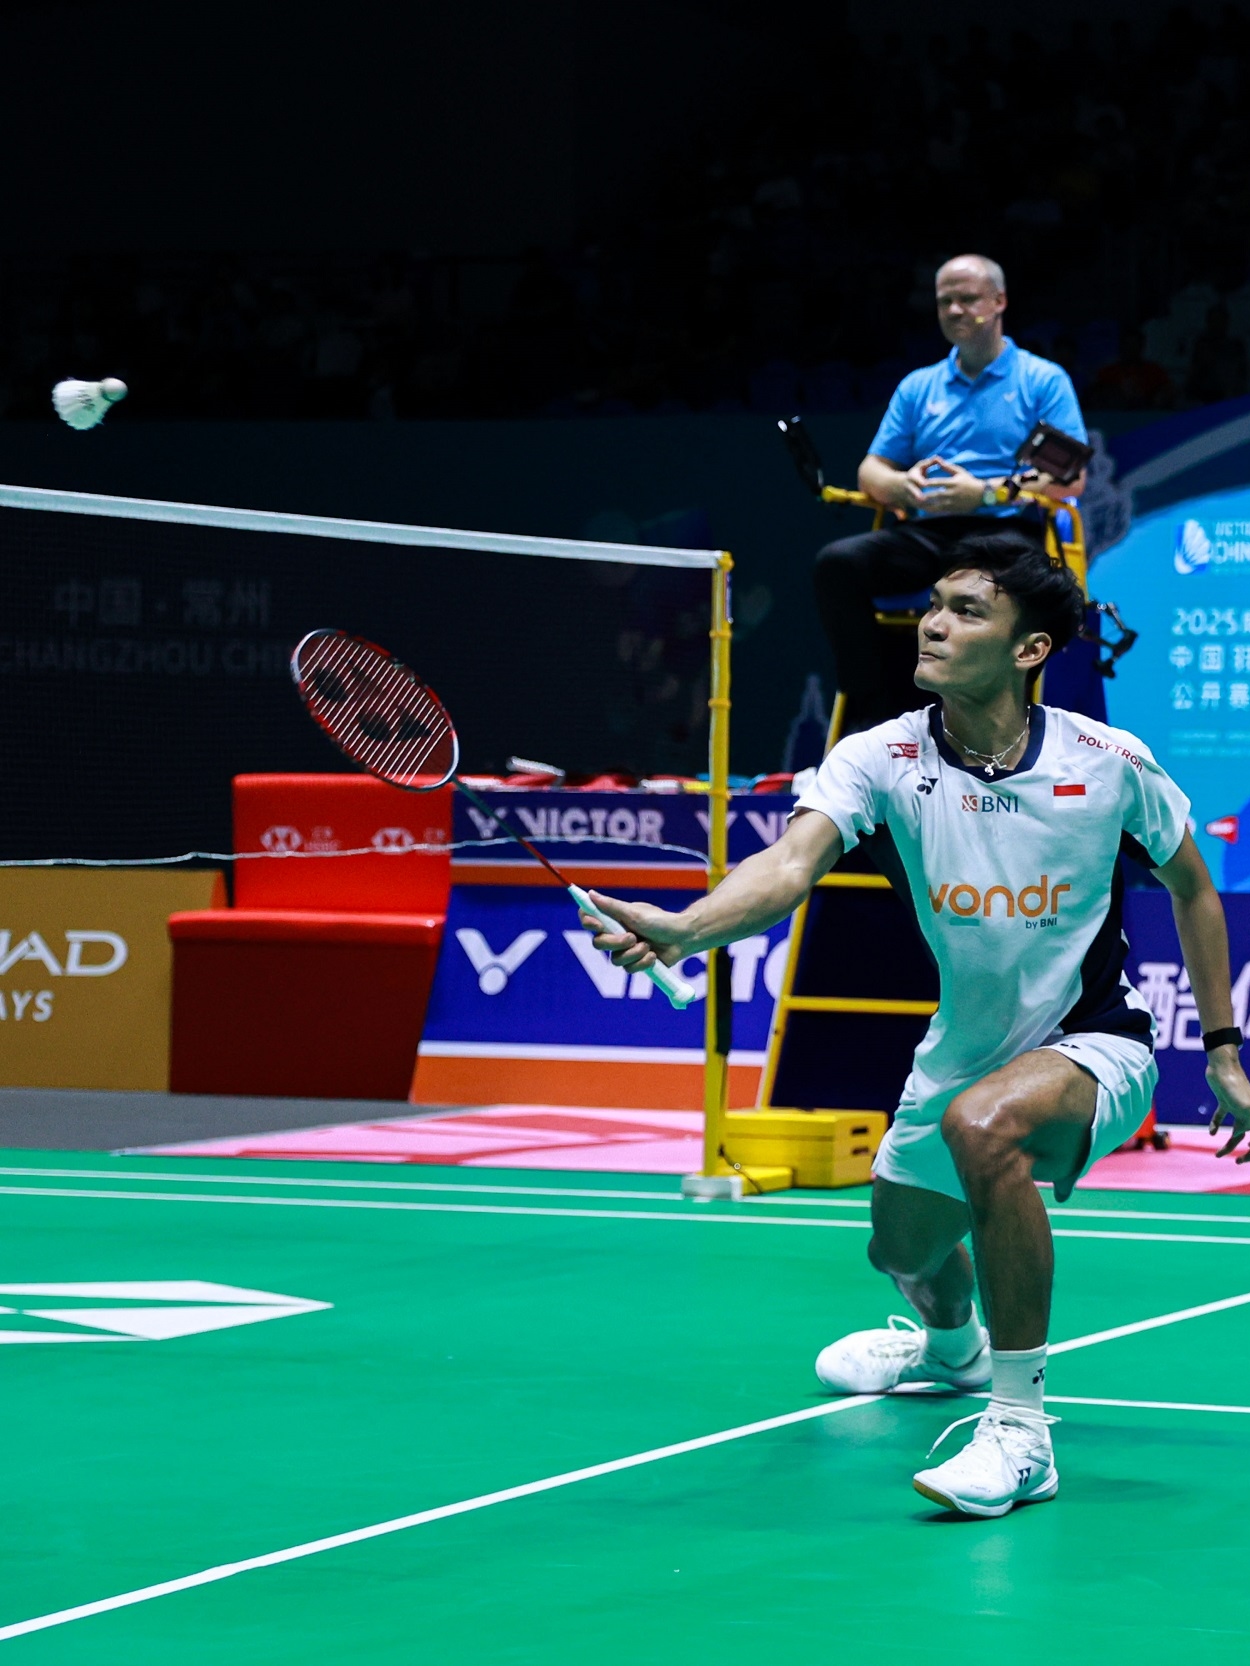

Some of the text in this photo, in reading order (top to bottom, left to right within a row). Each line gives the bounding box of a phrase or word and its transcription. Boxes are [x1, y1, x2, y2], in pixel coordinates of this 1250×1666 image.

[221, 639, 292, 677] CHI
[981, 795, 1019, 814] BNI
[515, 806, 666, 845] VICTOR
[928, 874, 1071, 918] vondr
[1025, 917, 1058, 930] by BNI
